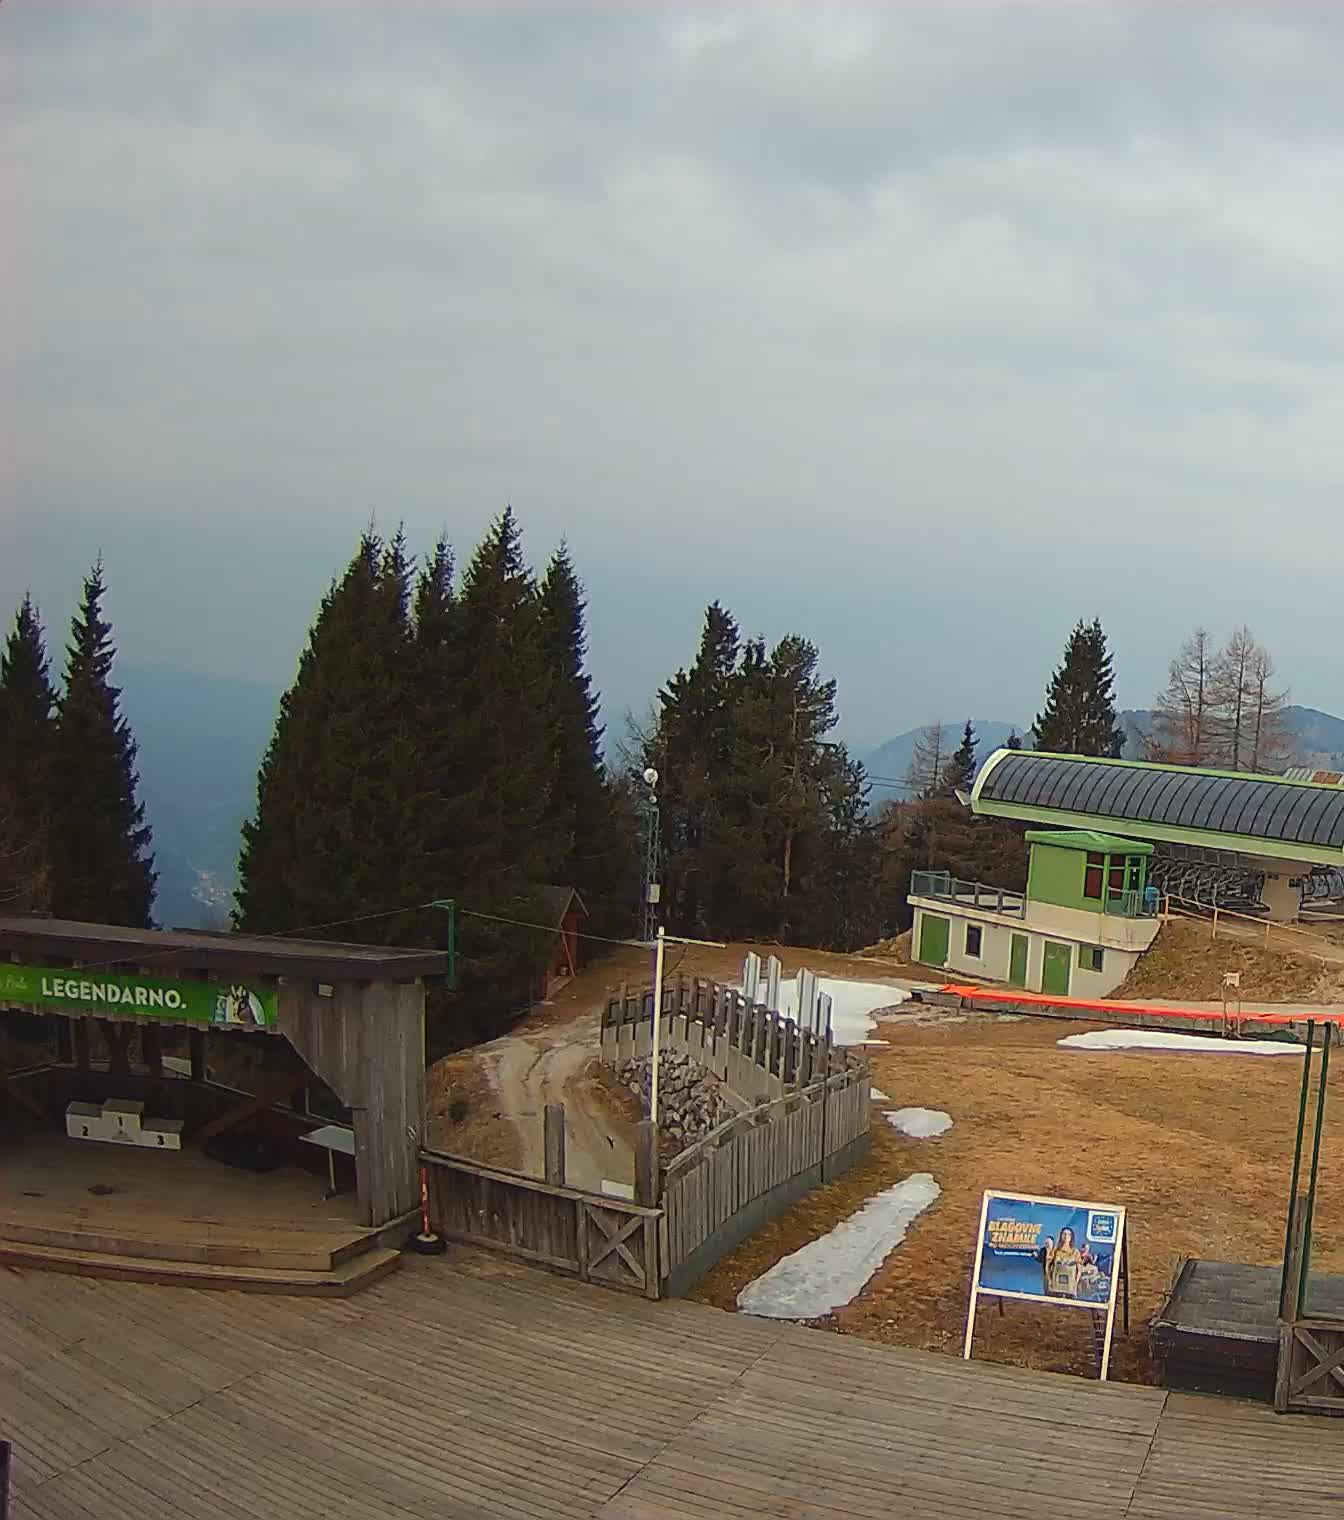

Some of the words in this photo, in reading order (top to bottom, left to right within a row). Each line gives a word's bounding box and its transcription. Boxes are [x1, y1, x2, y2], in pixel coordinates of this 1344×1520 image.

[41, 976, 187, 1009] LEGENDARNO.
[82, 1126, 89, 1137] 2
[157, 1135, 165, 1146] 3
